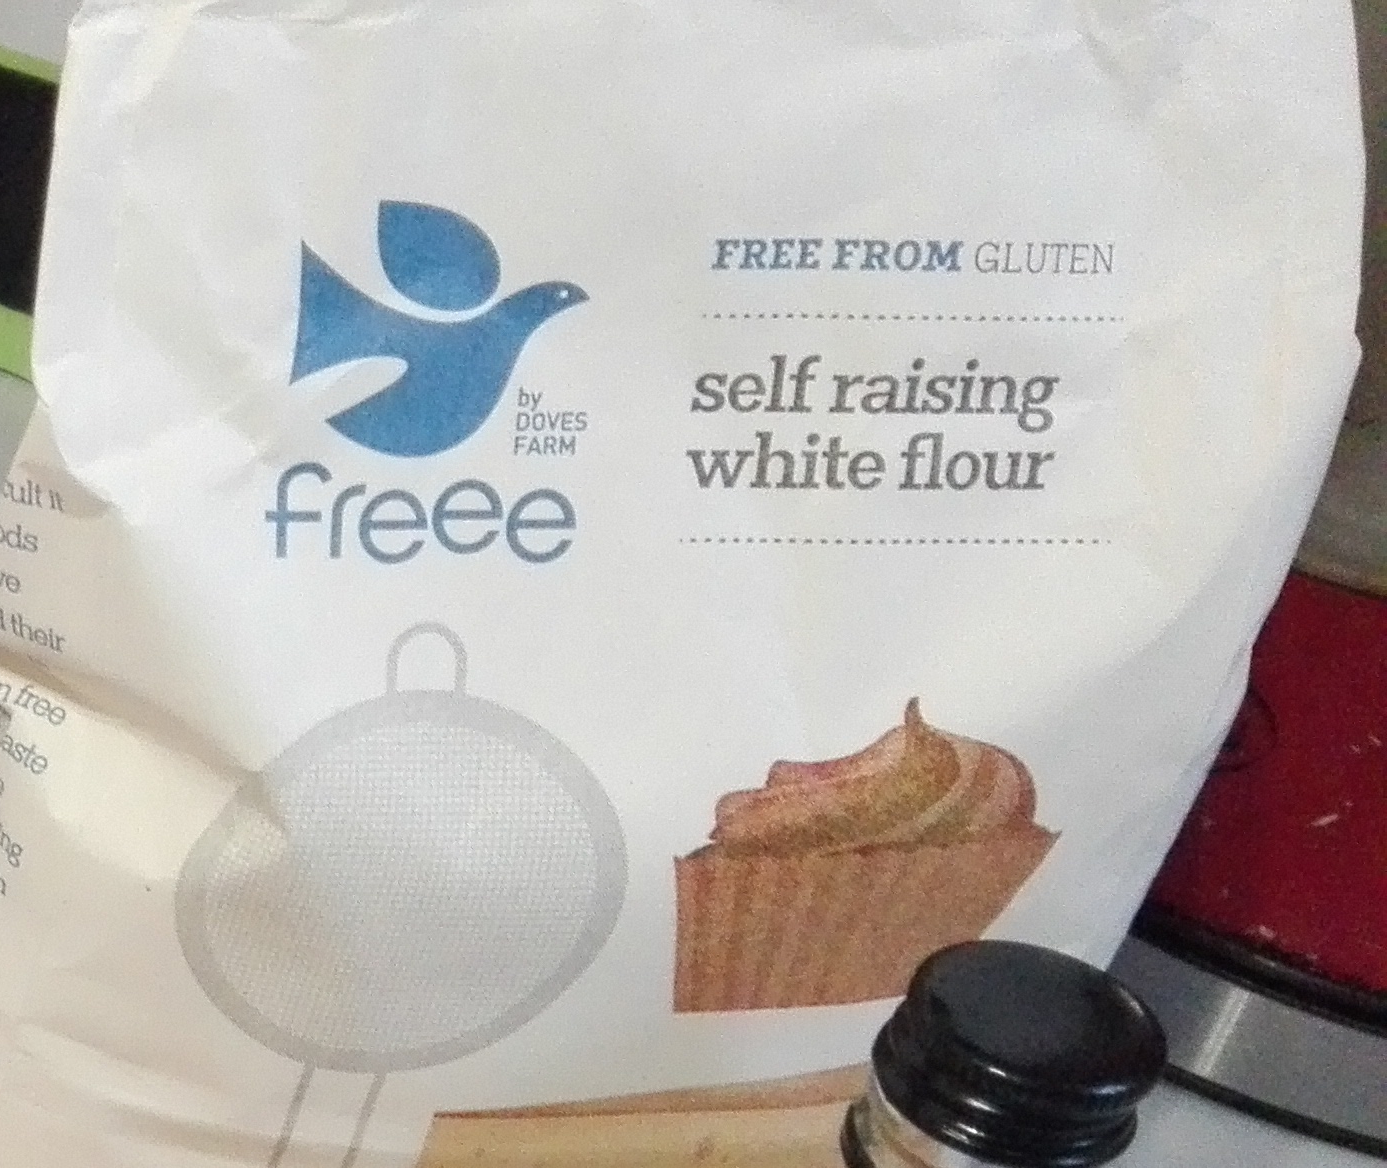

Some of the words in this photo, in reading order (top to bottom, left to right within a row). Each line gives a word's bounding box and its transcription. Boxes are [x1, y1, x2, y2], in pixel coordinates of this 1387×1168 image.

[711, 238, 823, 274] FREE
[831, 238, 964, 274] FROM
[973, 241, 1116, 276] GLUTEN
[516, 388, 543, 414] by
[691, 355, 824, 415] self
[827, 358, 1059, 433] raising
[515, 411, 589, 433] DOVES
[513, 435, 577, 458] FARM
[687, 432, 886, 492] white
[899, 432, 1055, 493] flour
[264, 462, 577, 566] freee
[10, 613, 67, 653] their
[13, 684, 67, 727] free
